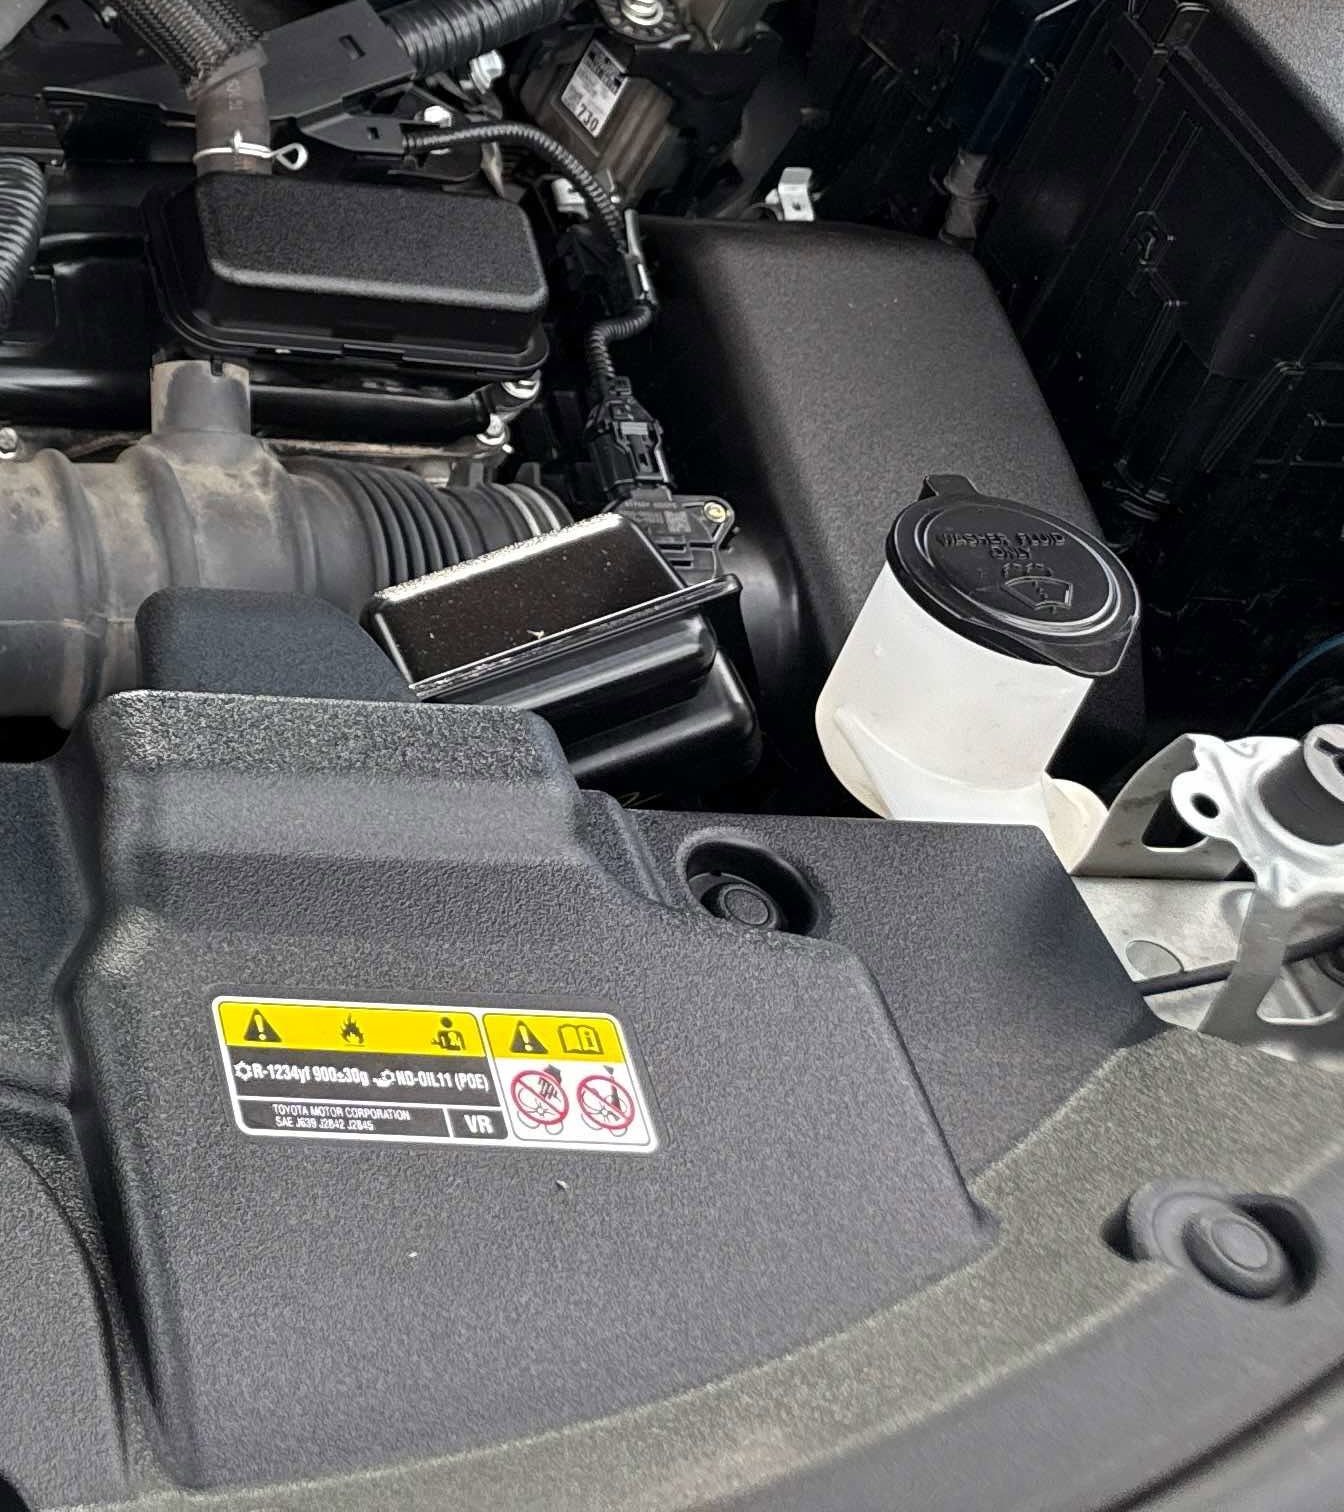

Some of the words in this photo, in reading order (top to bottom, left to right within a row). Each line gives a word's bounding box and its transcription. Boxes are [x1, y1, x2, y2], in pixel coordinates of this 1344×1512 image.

[576, 102, 600, 131] 730
[252, 1062, 311, 1084] R-1234yf
[396, 1070, 453, 1089] ND-OIL11
[454, 1072, 490, 1093] (POE)
[272, 1103, 309, 1117] TOYOTA
[310, 1105, 344, 1118] MOTOR
[345, 1107, 411, 1121] CORPORATION
[275, 1116, 294, 1128] SAE
[463, 1114, 495, 1134] VR
